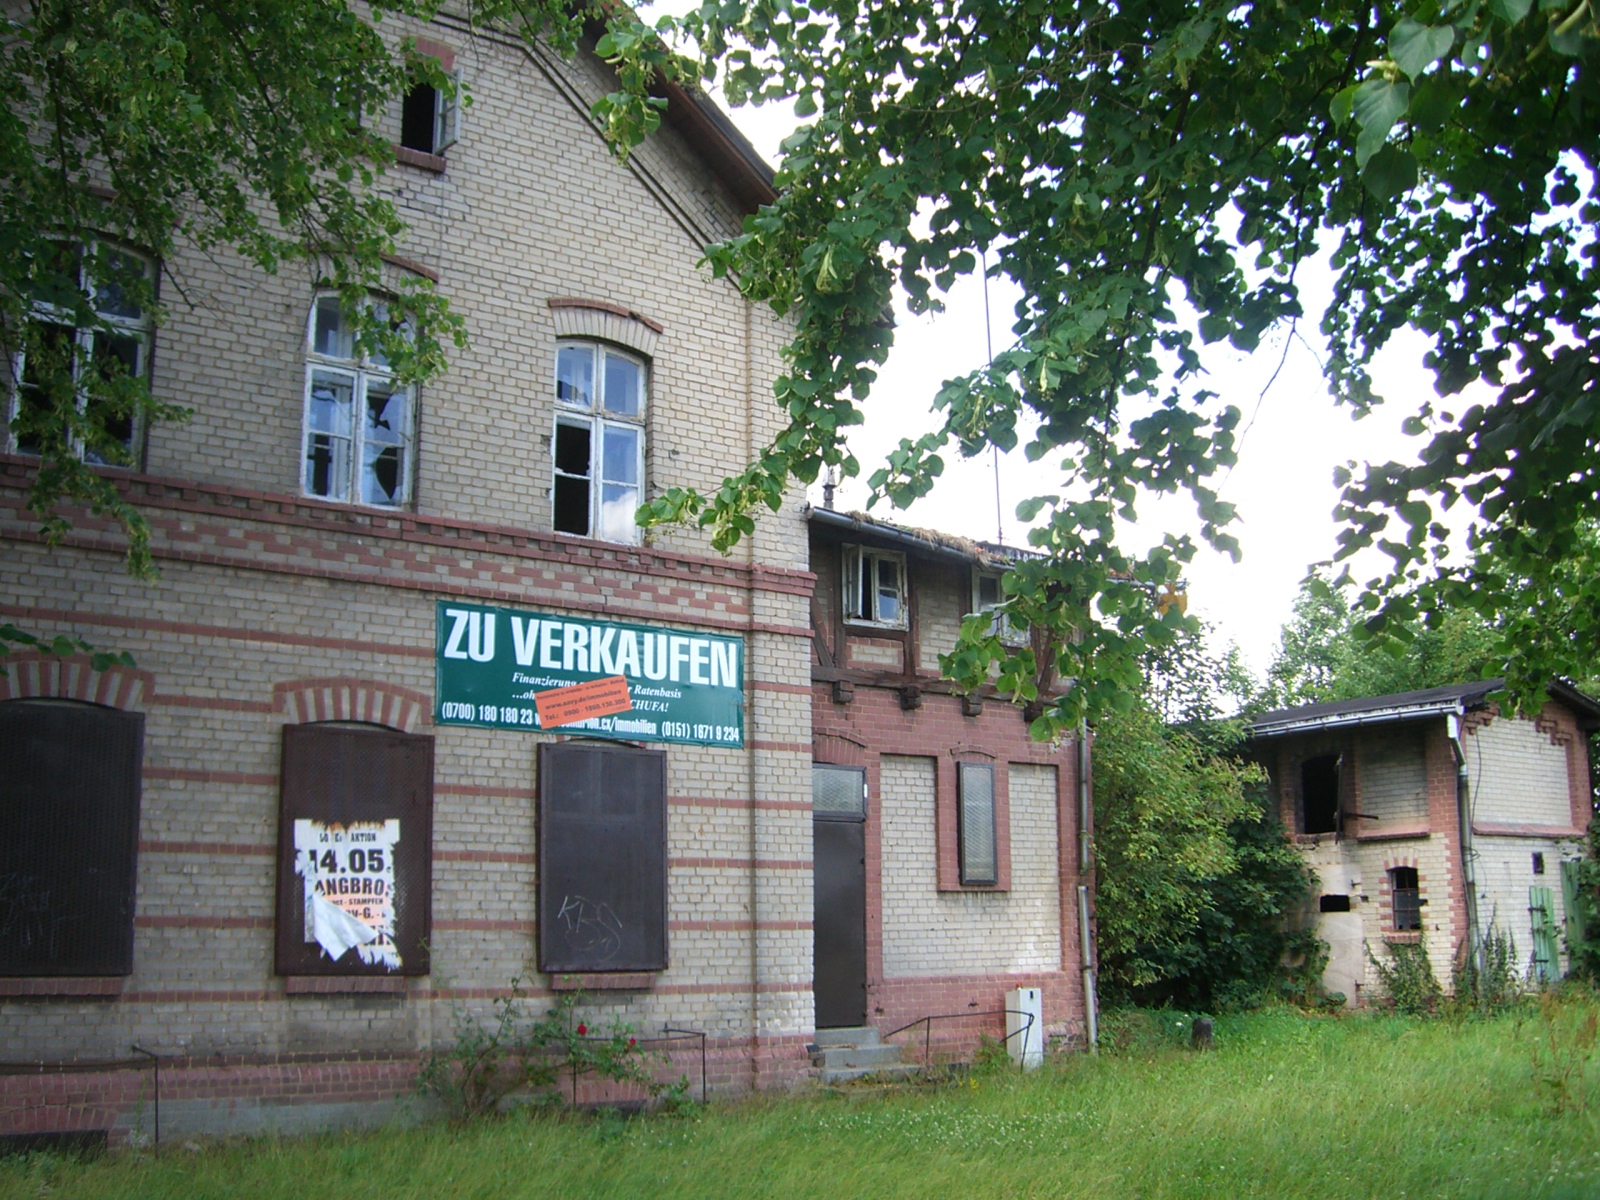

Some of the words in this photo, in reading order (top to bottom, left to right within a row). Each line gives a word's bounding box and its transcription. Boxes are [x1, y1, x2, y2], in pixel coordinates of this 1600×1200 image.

[444, 608, 496, 663] ZU
[510, 616, 737, 688] VERKAUFEN
[512, 672, 577, 688] Finanzierung
[512, 689, 536, 700] ...oh
[634, 684, 682, 699] Ratenbasis
[630, 699, 669, 712] CHUFA!
[442, 702, 475, 721] (0700)
[479, 705, 498, 722] 180
[500, 707, 518, 724] 180
[520, 709, 533, 725] 23
[661, 721, 691, 739] (0151)
[693, 723, 713, 739] 1671
[716, 725, 723, 741] 9
[723, 726, 740, 742] 234
[350, 832, 377, 843] AKTION
